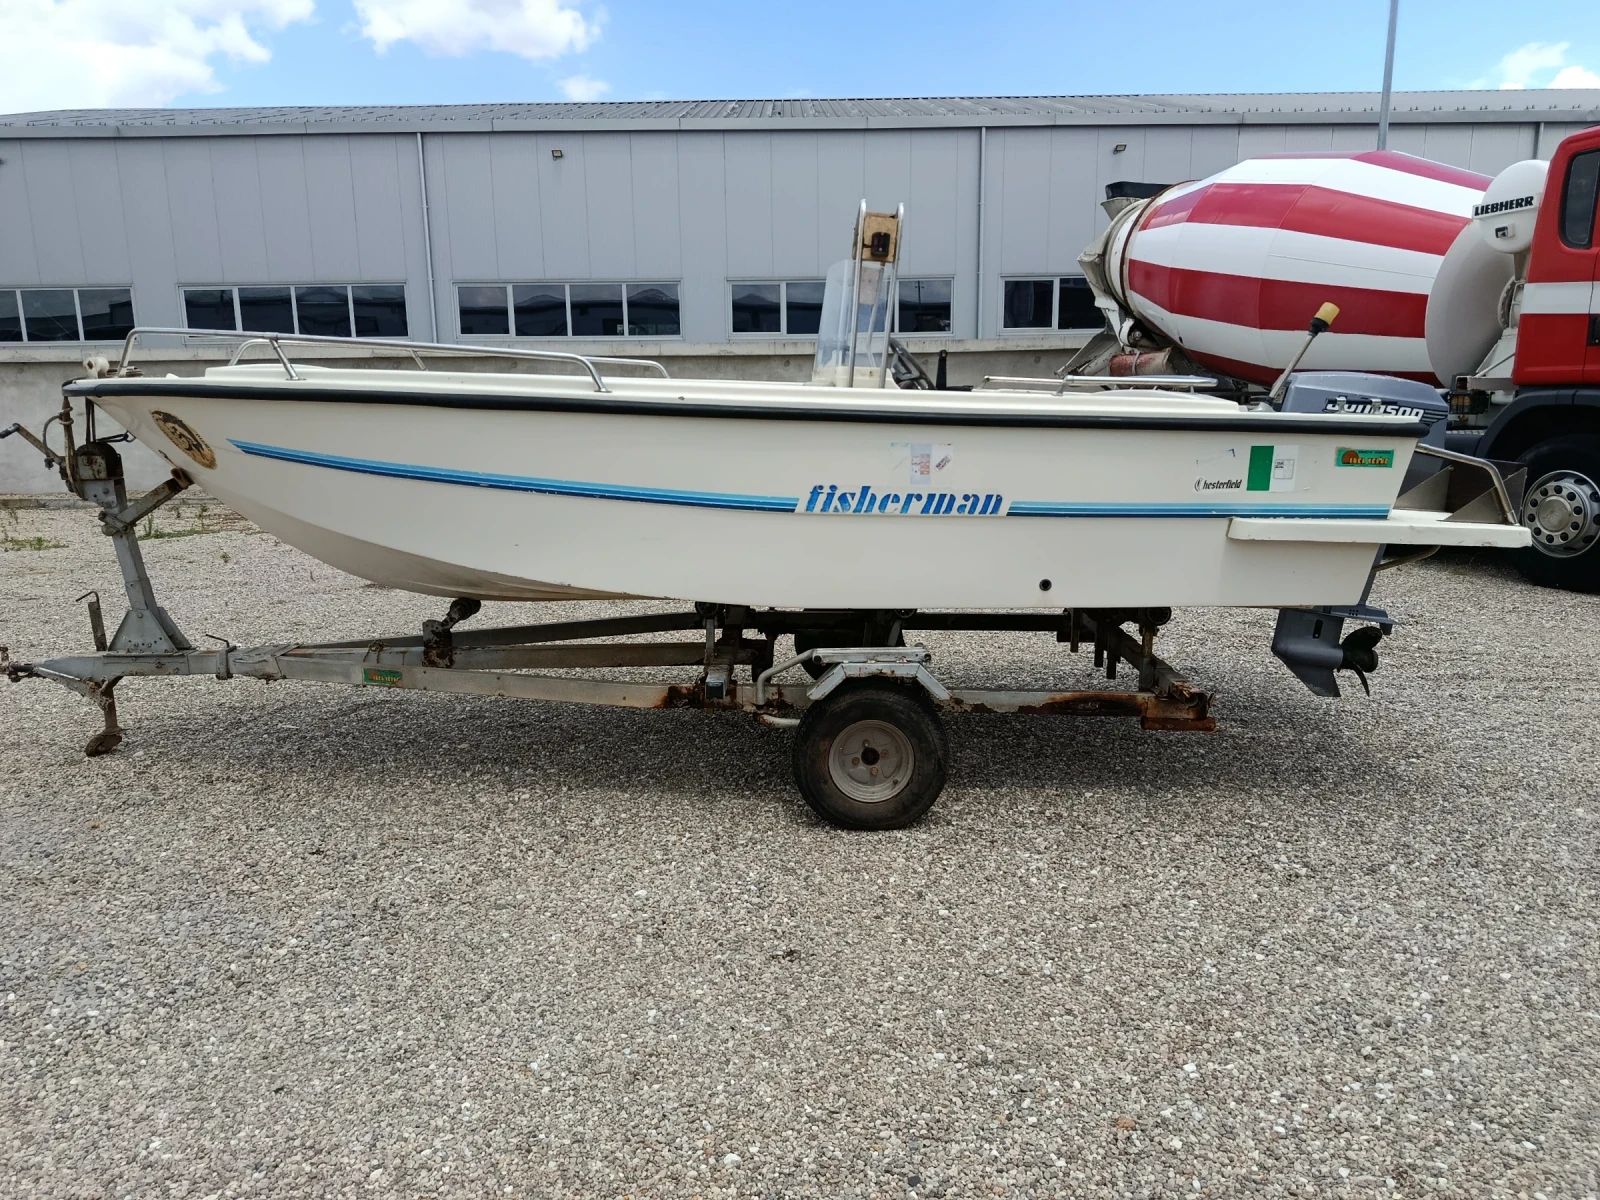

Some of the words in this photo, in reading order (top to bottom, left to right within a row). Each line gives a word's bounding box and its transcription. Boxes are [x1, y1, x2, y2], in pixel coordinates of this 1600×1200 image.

[1474, 196, 1534, 216] LIEBHERR
[1194, 477, 1242, 492] Chesterfield
[804, 484, 1003, 515] fisherman
